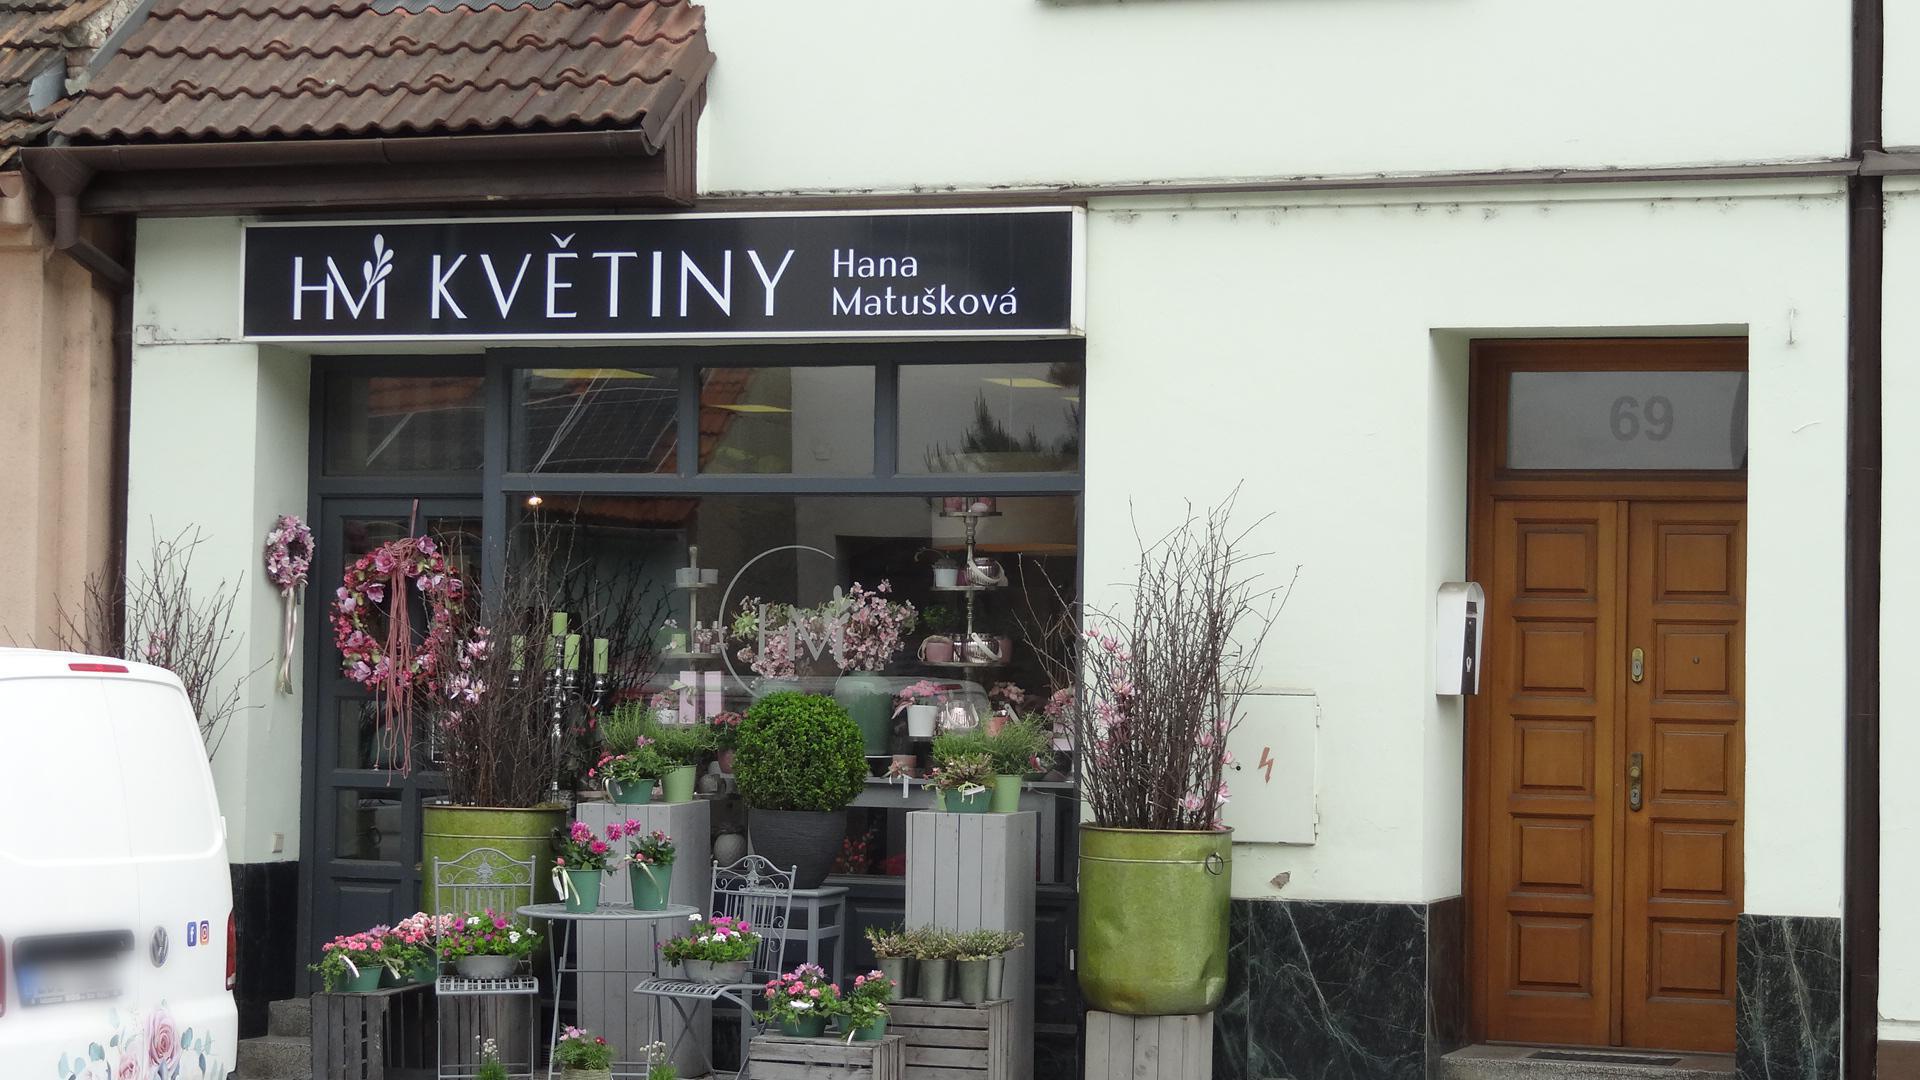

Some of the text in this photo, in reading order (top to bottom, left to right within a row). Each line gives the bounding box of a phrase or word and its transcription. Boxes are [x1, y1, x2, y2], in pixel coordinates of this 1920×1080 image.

[431, 233, 795, 320] KVĚTINY
[832, 248, 918, 278] Hana
[832, 286, 1018, 316] Matušková
[1609, 395, 1674, 441] 69
